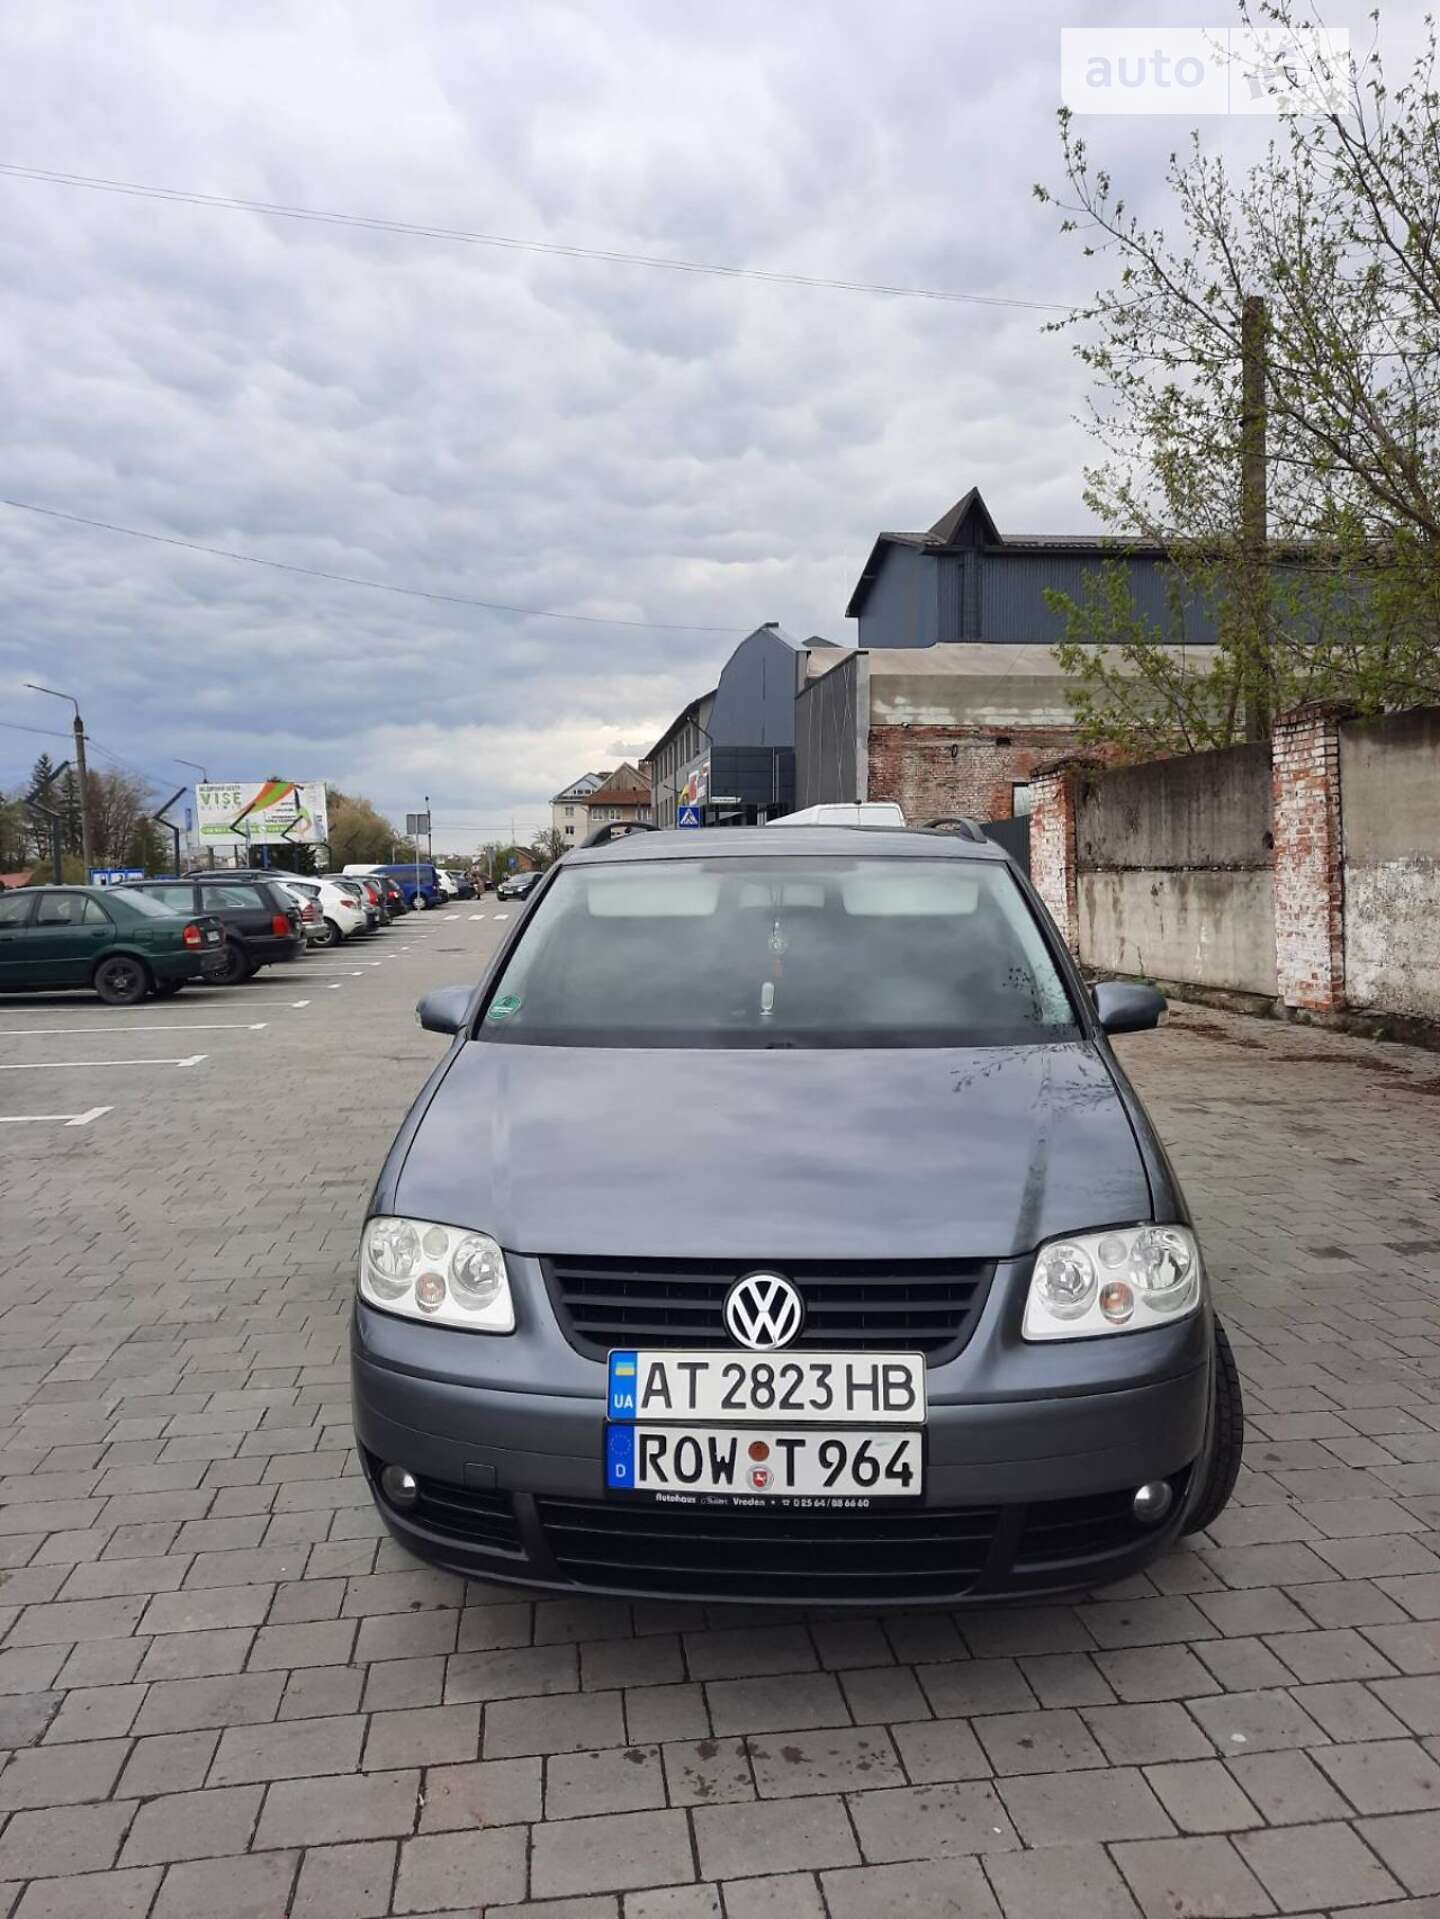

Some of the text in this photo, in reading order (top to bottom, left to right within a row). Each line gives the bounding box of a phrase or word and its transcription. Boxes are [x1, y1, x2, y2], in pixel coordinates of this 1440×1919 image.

[200, 792, 241, 805] VISE
[641, 1362, 916, 1412] AT 2823 HB
[614, 1393, 634, 1409] UA
[639, 1433, 914, 1487] ROW T 964
[615, 1463, 627, 1478] D
[655, 1493, 696, 1504] Autohaus
[733, 1497, 765, 1506] Vreden
